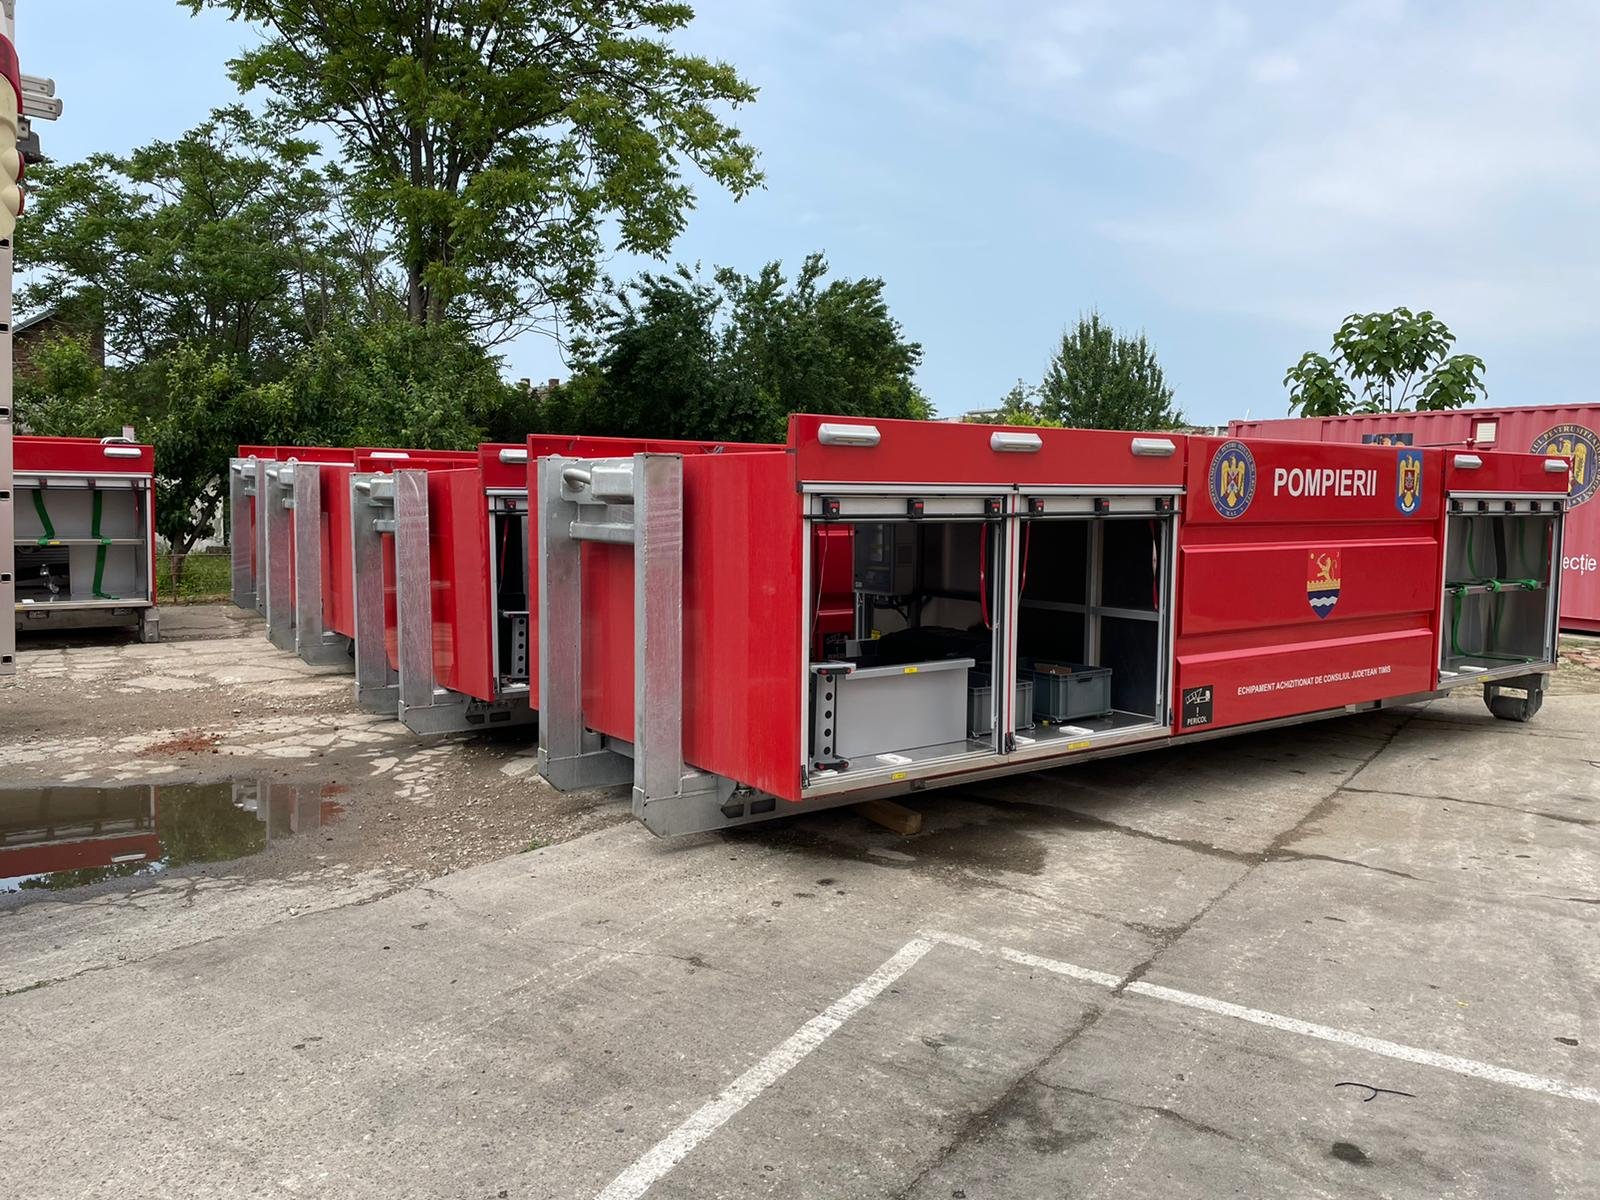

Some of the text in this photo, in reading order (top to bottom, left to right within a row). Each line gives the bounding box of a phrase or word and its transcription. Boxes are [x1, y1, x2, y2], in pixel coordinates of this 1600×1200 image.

[1273, 467, 1377, 497] POMPIERII
[1562, 553, 1597, 576] ecție
[1237, 682, 1276, 697] ECHIPAMENT
[1314, 675, 1323, 685] DE
[1323, 671, 1351, 683] CONSILIUL
[1186, 715, 1208, 726] PERICOL
